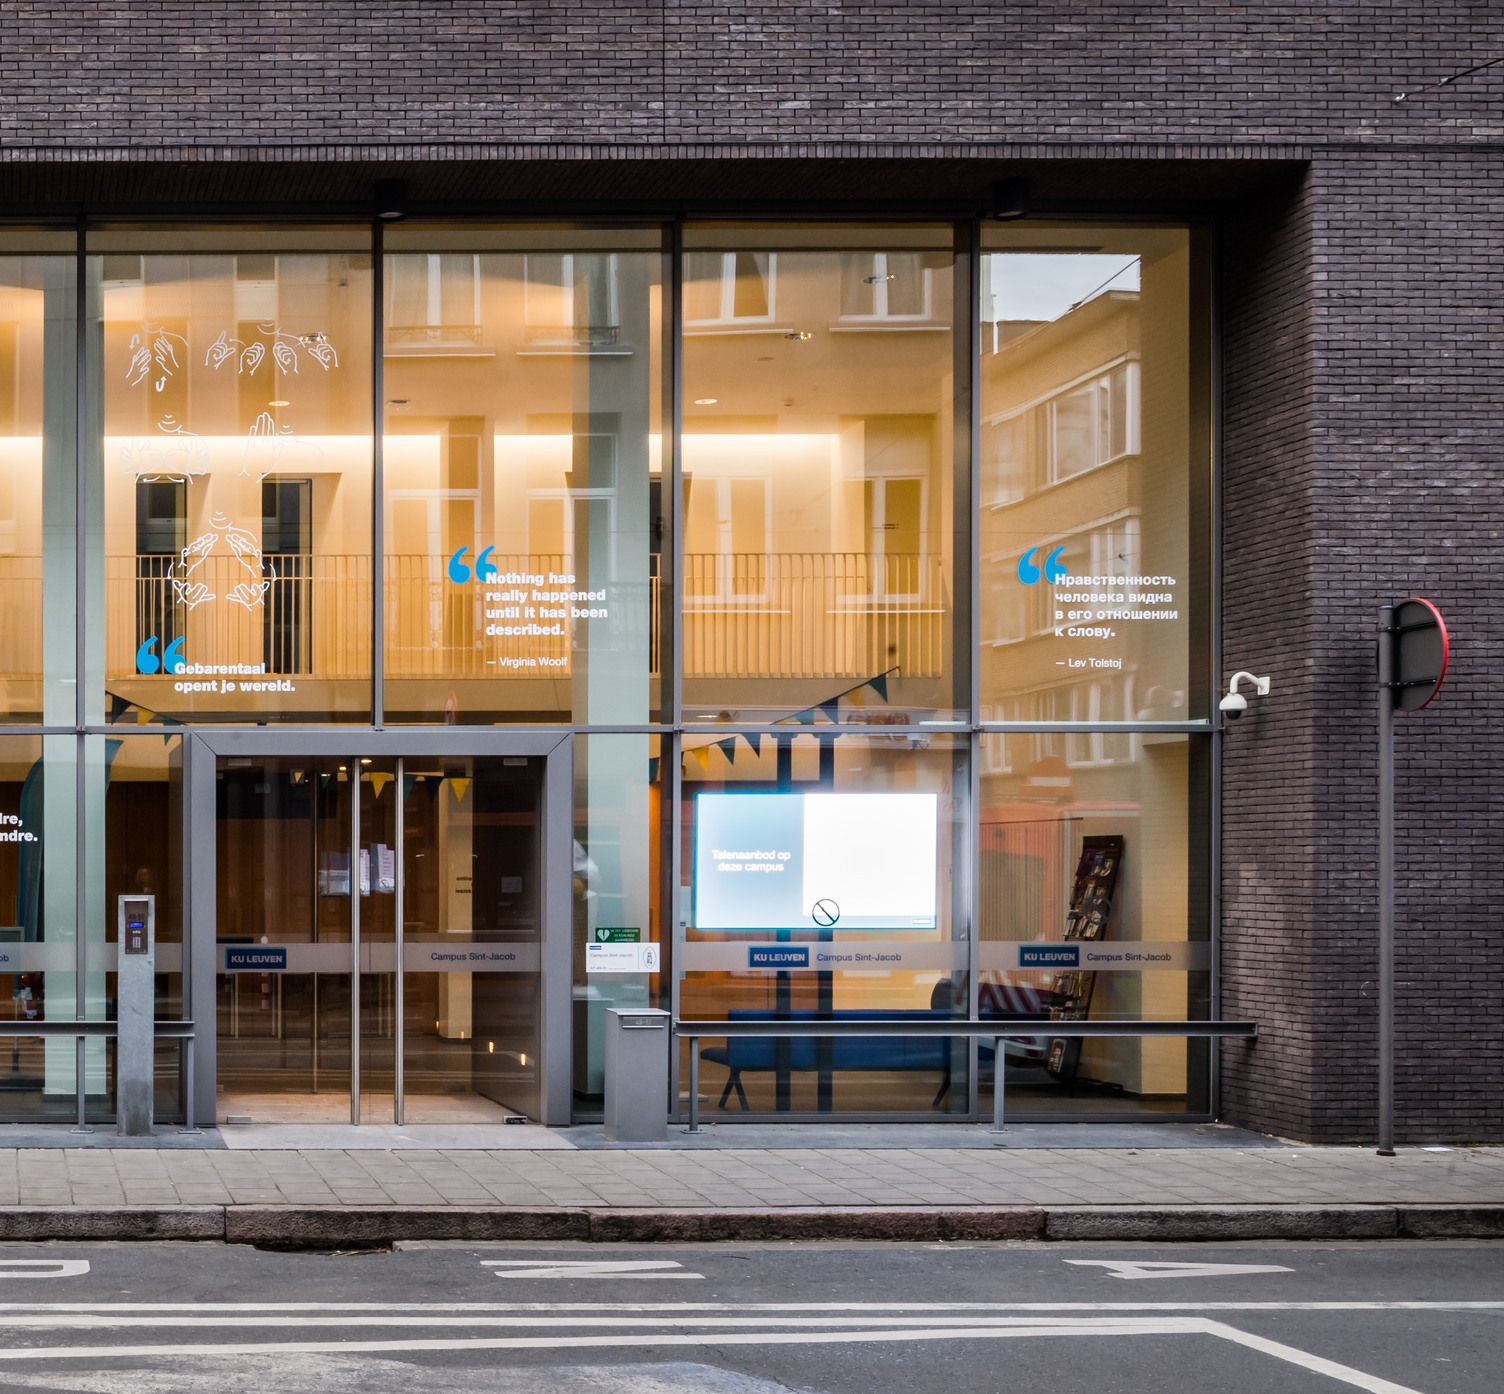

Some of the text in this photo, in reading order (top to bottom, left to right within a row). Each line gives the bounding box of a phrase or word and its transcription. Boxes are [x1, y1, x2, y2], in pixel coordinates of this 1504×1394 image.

[485, 572, 576, 586] Nothing has
[1055, 573, 1176, 588] Нравственность
[485, 588, 606, 604] really happened
[1055, 593, 1173, 604] человека видна
[486, 606, 608, 618] until it has been
[1055, 610, 1178, 620] в его отношении
[485, 623, 565, 636] described.
[1055, 627, 1116, 640] к слову.
[499, 657, 536, 668] Virginia
[538, 656, 568, 666] Woolf
[1068, 658, 1086, 668] Lev
[1088, 658, 1122, 669] Tolstoj
[174, 662, 266, 675] Gebarentaal
[174, 679, 296, 694] opent je wereld.
[711, 849, 791, 862] Talenaanbod op
[718, 862, 784, 874] deze campus
[231, 955, 282, 963] KU LEUVEN
[430, 953, 516, 962] Campus Sint-Jacob
[754, 953, 805, 961] KU LEUVEN
[816, 953, 901, 962] Campus Sint-Jacob
[1024, 953, 1075, 961] KU LEUVEN
[1086, 953, 1171, 962] Campus Sint-Jacob
